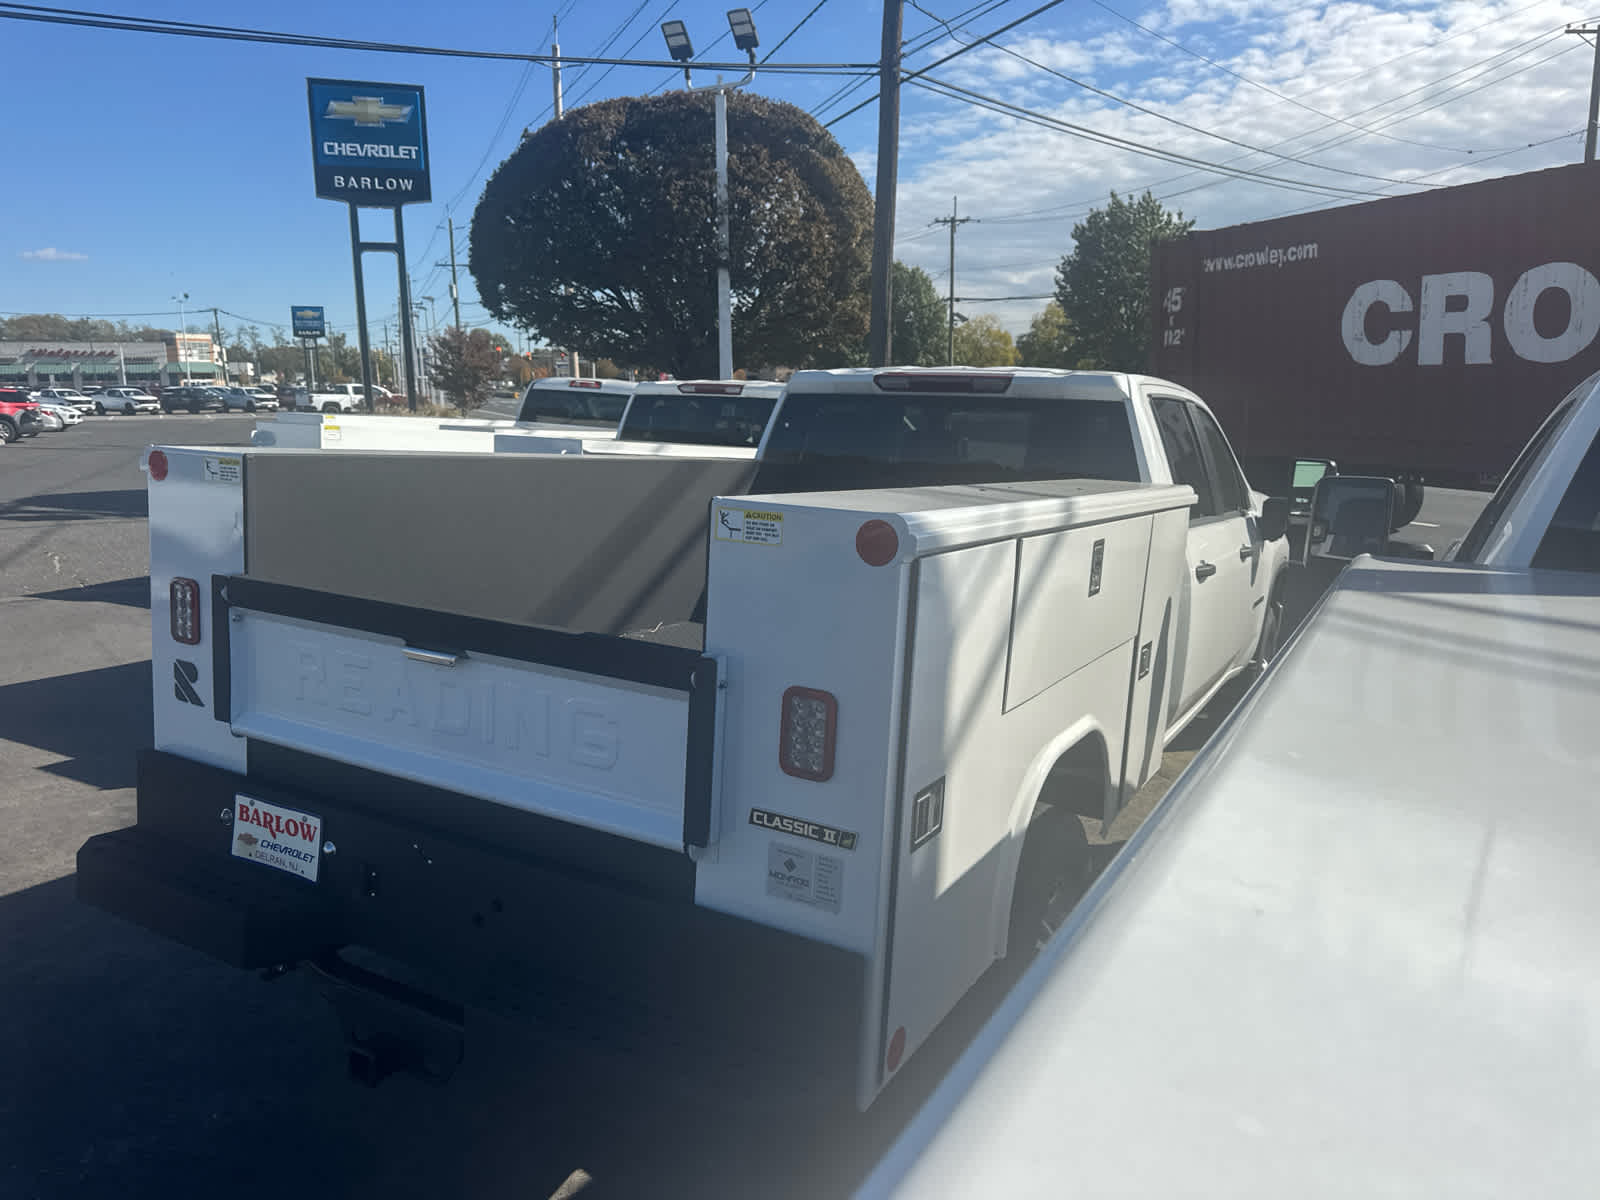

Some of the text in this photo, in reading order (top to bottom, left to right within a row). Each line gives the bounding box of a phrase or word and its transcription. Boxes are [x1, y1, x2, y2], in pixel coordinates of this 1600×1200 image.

[323, 142, 418, 159] CHEVROLET
[334, 175, 413, 191] BARLOW
[1204, 243, 1319, 272] www.crowley.com
[1341, 262, 1600, 366] CRO
[752, 512, 782, 520] CAUTION
[293, 637, 621, 772] READING
[238, 803, 317, 842] BARLOW
[752, 810, 837, 843] CLASSIC II
[260, 840, 315, 864] CHEVROLET
